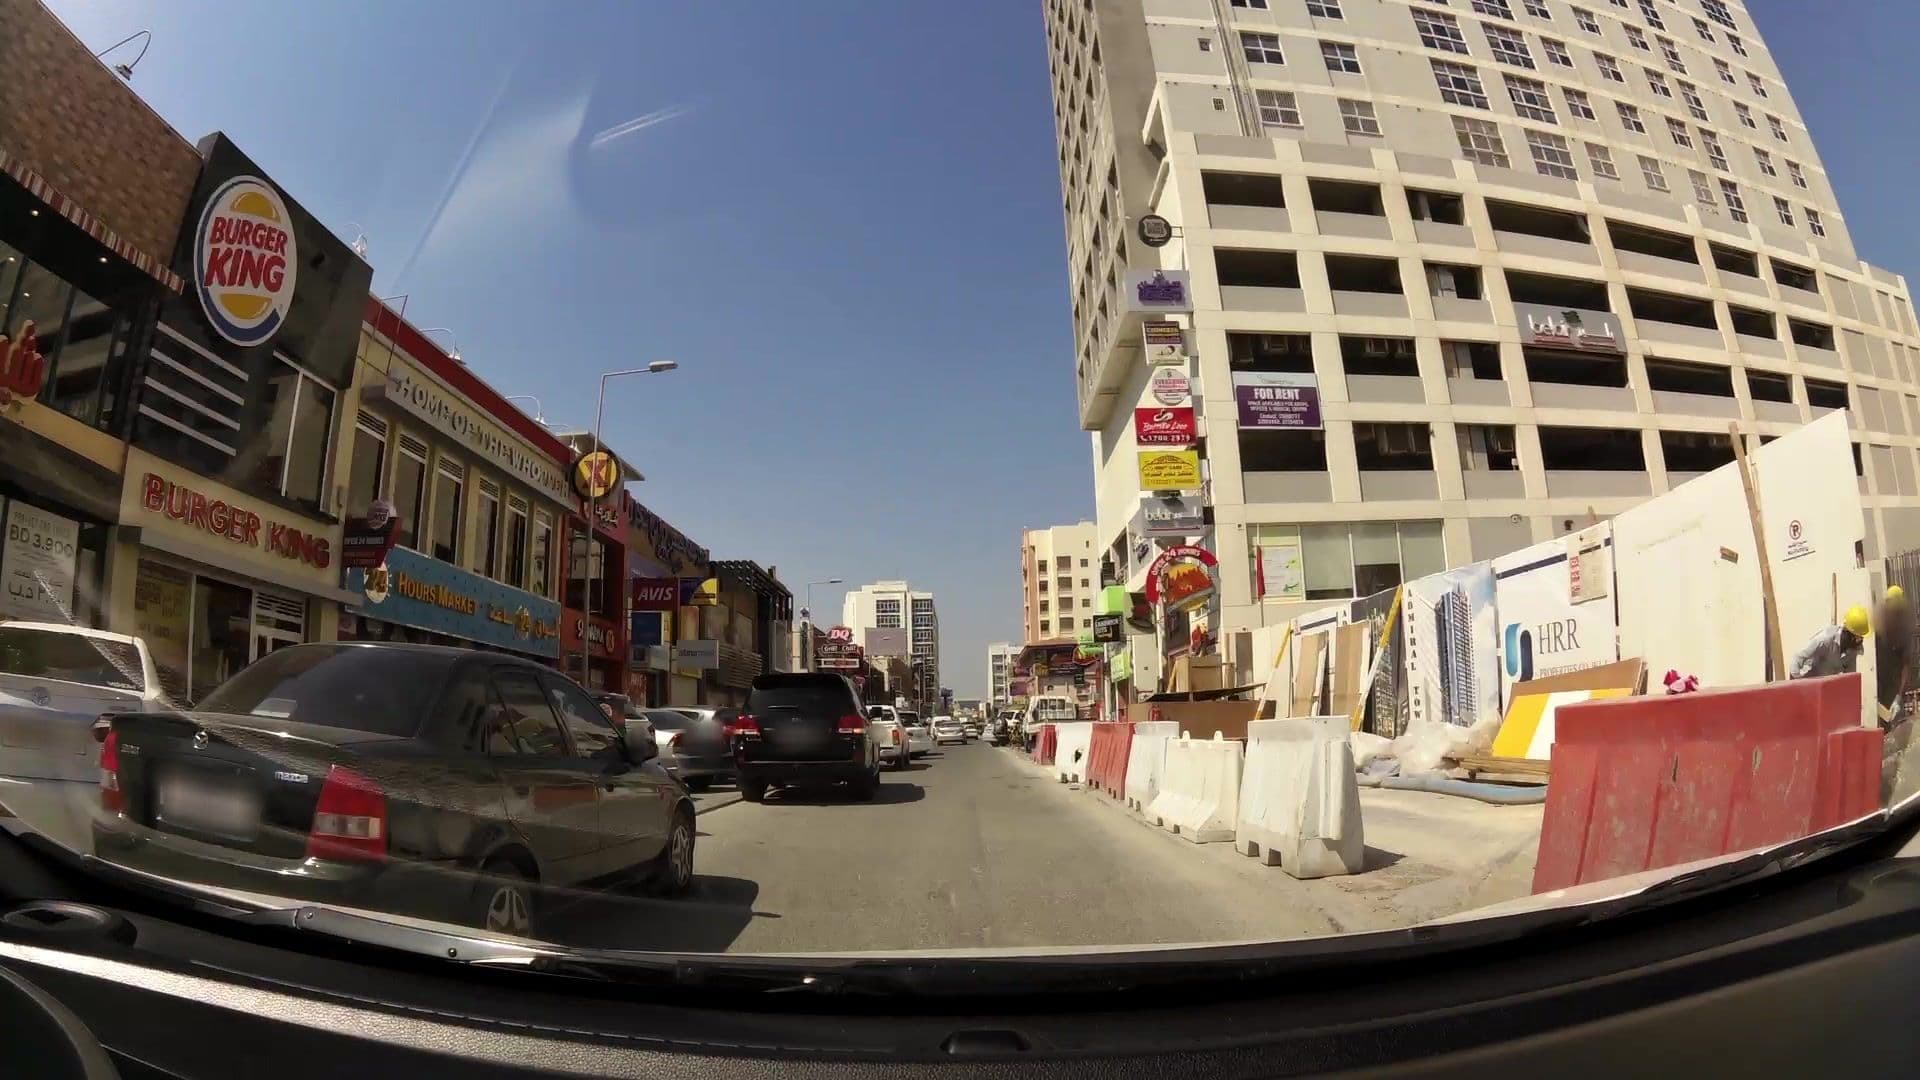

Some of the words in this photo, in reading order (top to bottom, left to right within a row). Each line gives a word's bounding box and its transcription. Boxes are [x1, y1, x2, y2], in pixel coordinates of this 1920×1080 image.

[210, 216, 288, 256] BURGER
[204, 247, 286, 293] KING
[1253, 387, 1274, 400] FOR
[1275, 388, 1300, 400] RENT
[9, 523, 30, 543] BD
[143, 472, 262, 547] BURGER
[264, 520, 331, 569] KING
[397, 571, 436, 604] HOURS
[637, 586, 674, 601] AVIS
[830, 629, 850, 641] DQ
[1407, 588, 1417, 671] ADMIRAL
[1538, 617, 1582, 656] HRR
